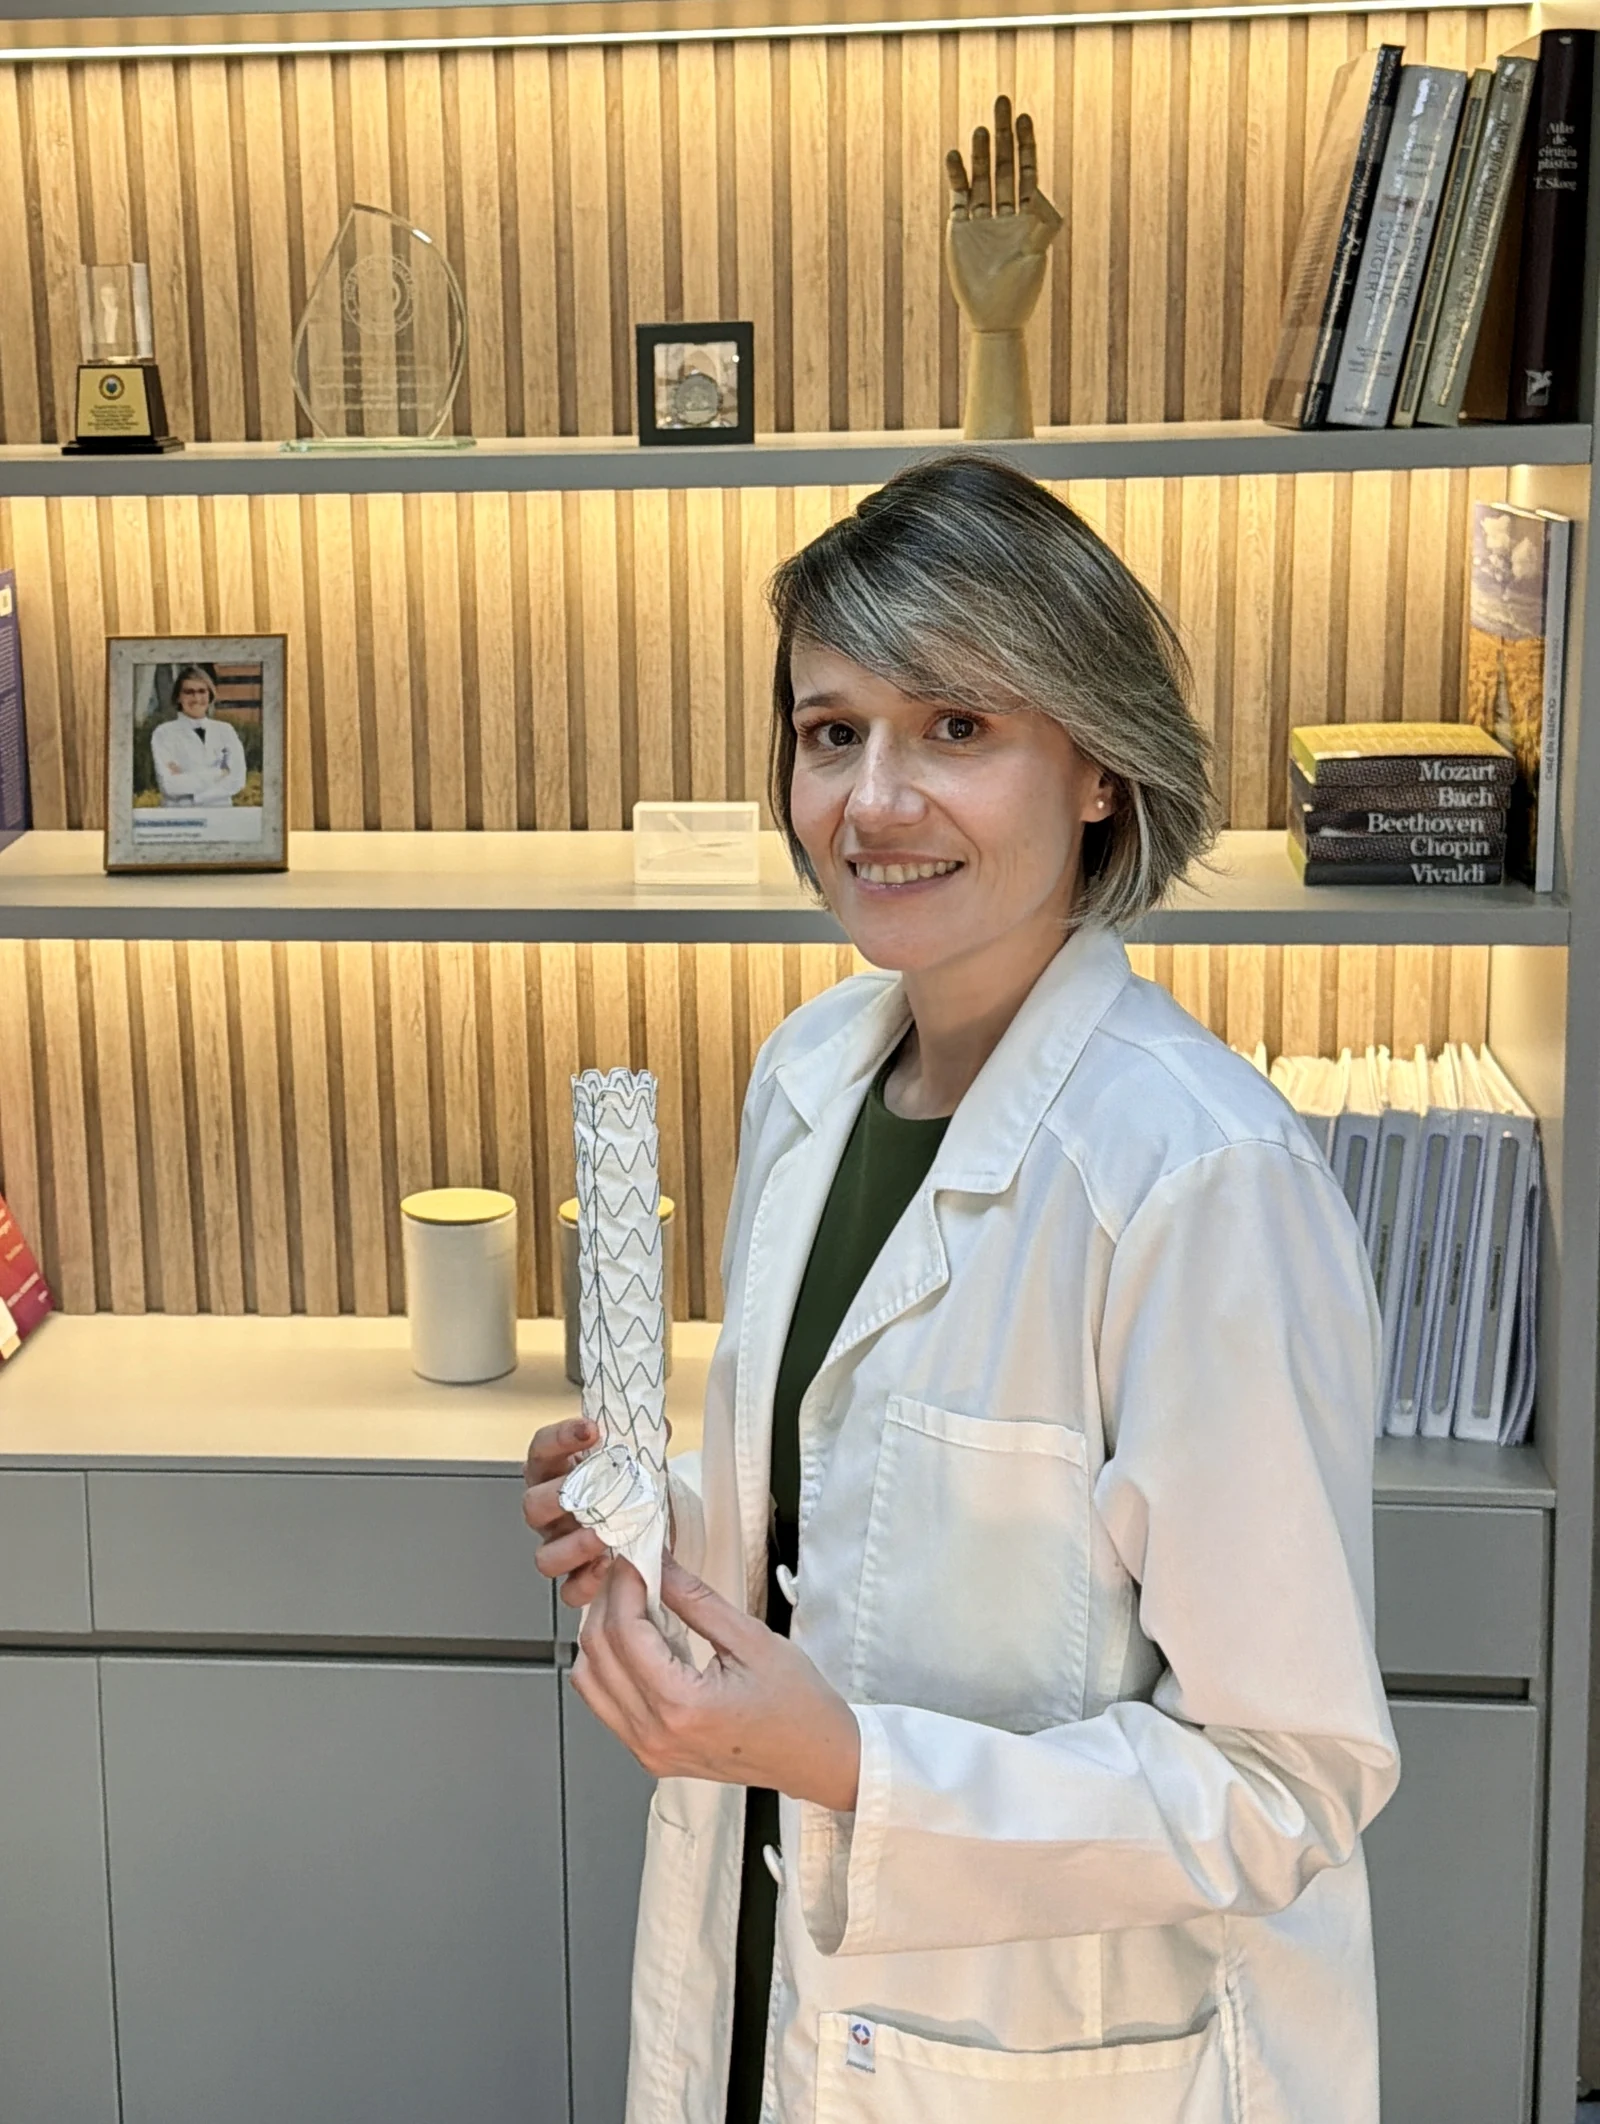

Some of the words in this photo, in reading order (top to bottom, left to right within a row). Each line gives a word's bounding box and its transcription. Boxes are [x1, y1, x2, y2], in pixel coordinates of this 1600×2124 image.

[1546, 121, 1575, 134] Atlas
[1553, 134, 1567, 146] de
[1364, 221, 1392, 302] SURGERY
[1381, 222, 1408, 306] PLASTIC
[1396, 226, 1423, 308] AESTHETIC
[1418, 760, 1496, 782] Mozart
[1438, 786, 1493, 807] Bach
[1367, 812, 1484, 833] Beethoven
[1410, 835, 1490, 860] Chopin
[1410, 863, 1486, 884] Vivaldi
